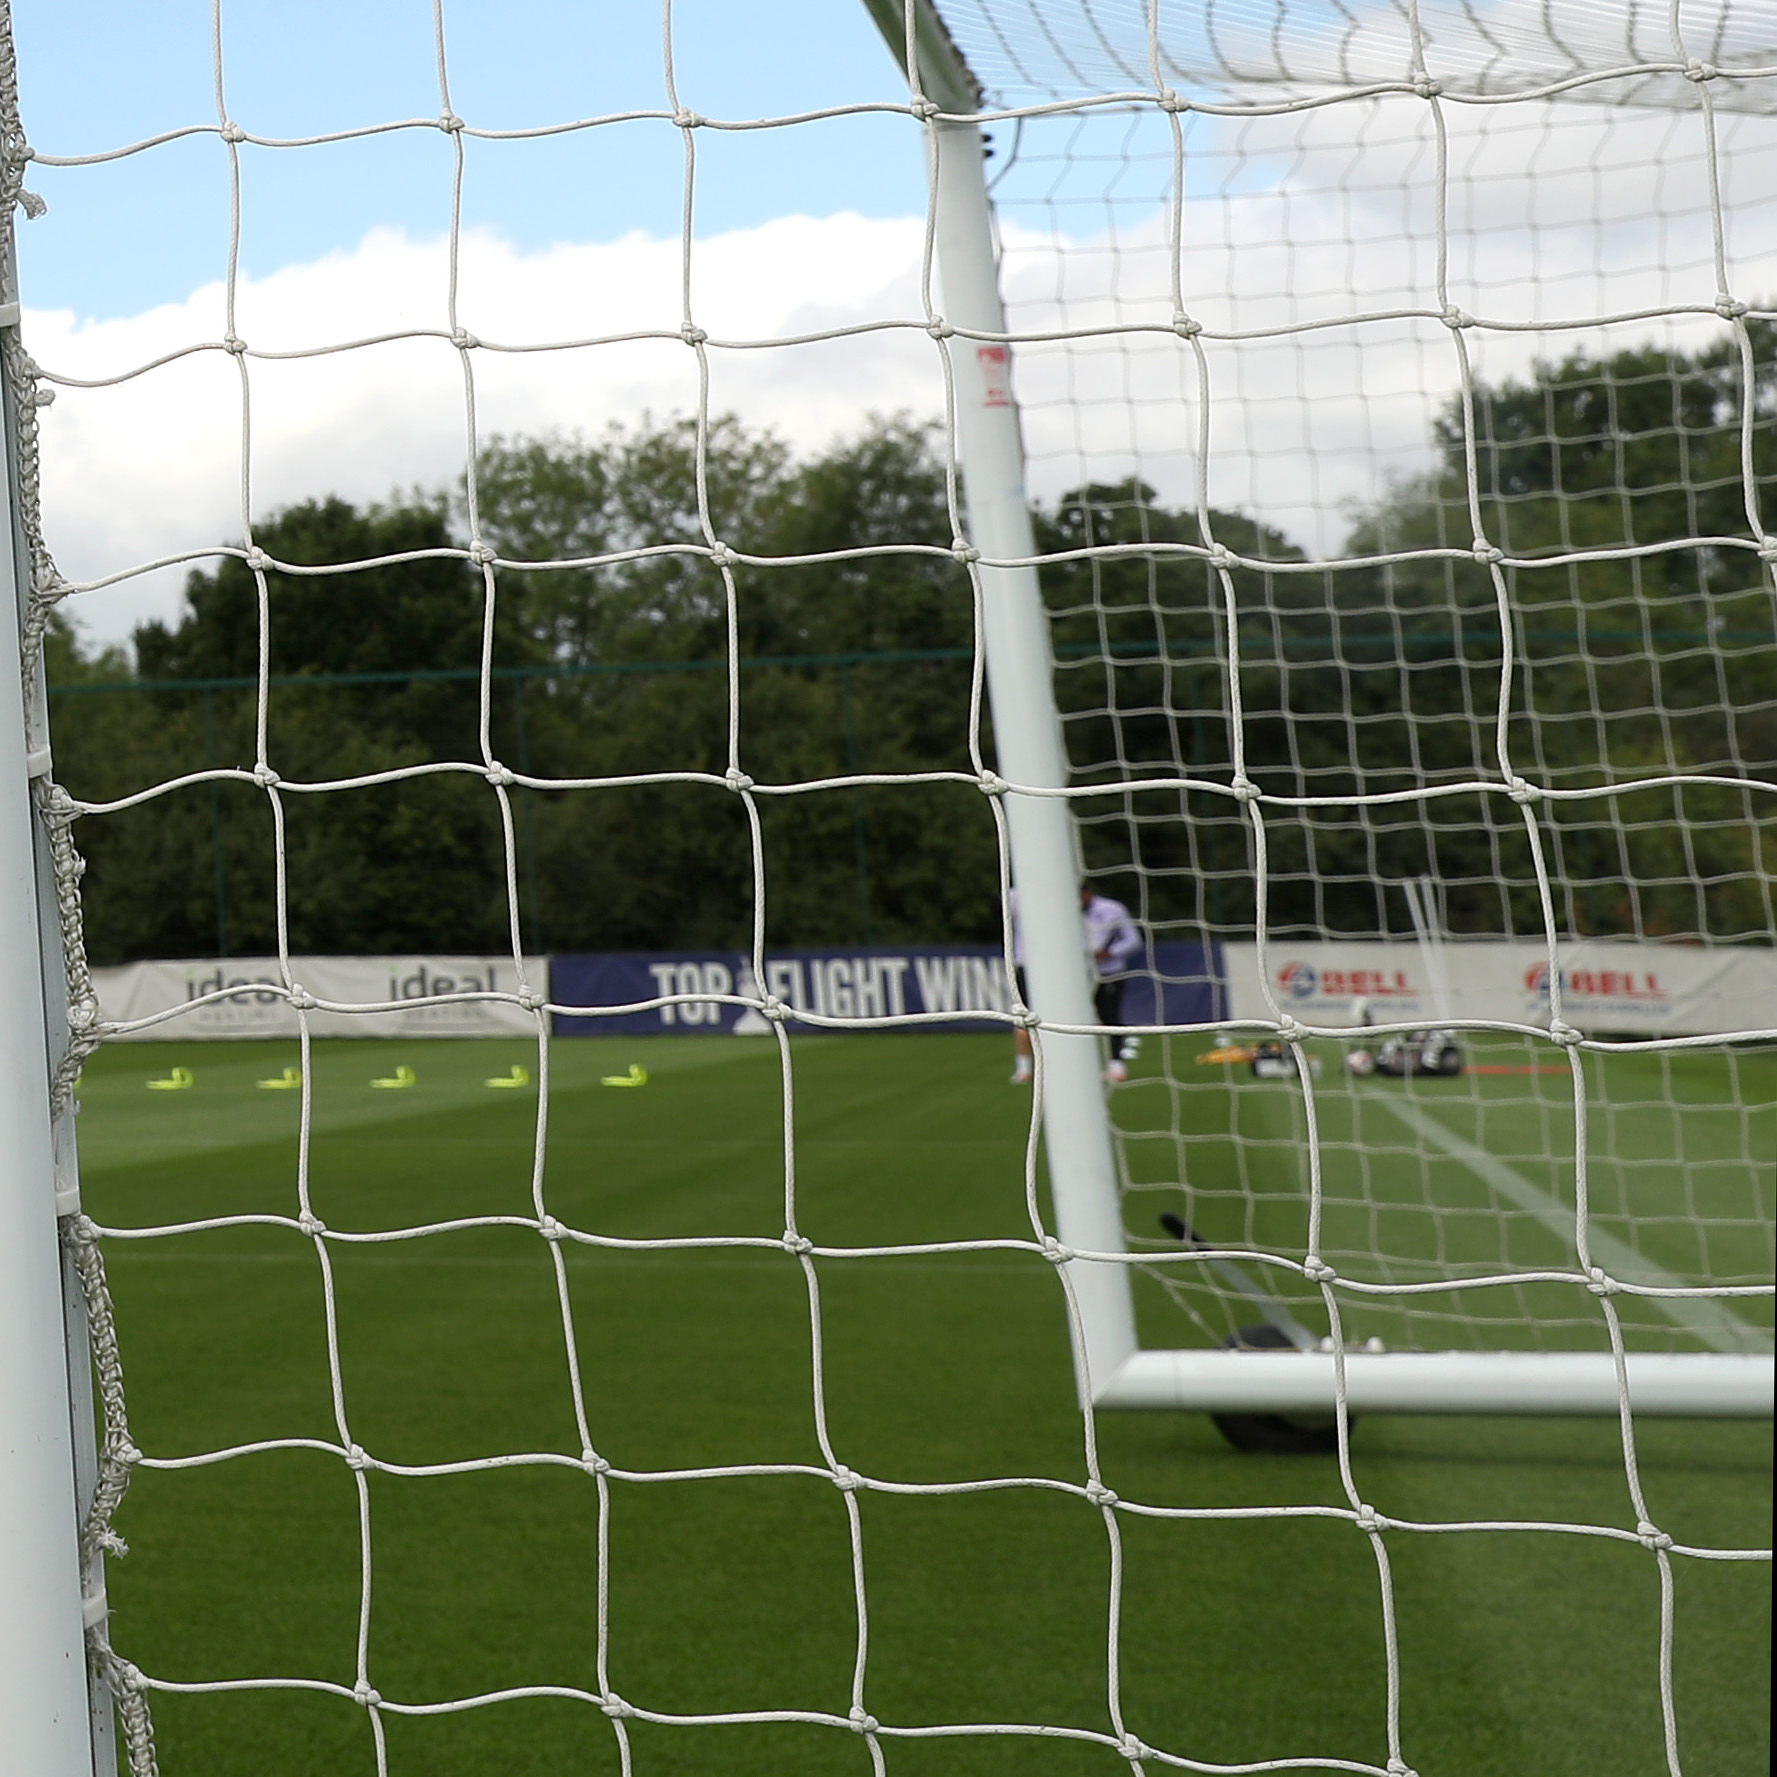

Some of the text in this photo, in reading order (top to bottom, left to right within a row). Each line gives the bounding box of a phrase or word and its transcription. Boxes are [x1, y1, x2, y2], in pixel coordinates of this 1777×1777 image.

[186, 966, 291, 1005] idea
[388, 964, 496, 1004] ideal
[649, 961, 733, 1025] TOP
[765, 957, 911, 1020] FLIGHT
[1321, 970, 1419, 996] BELL
[1570, 970, 1669, 1000] BELL
